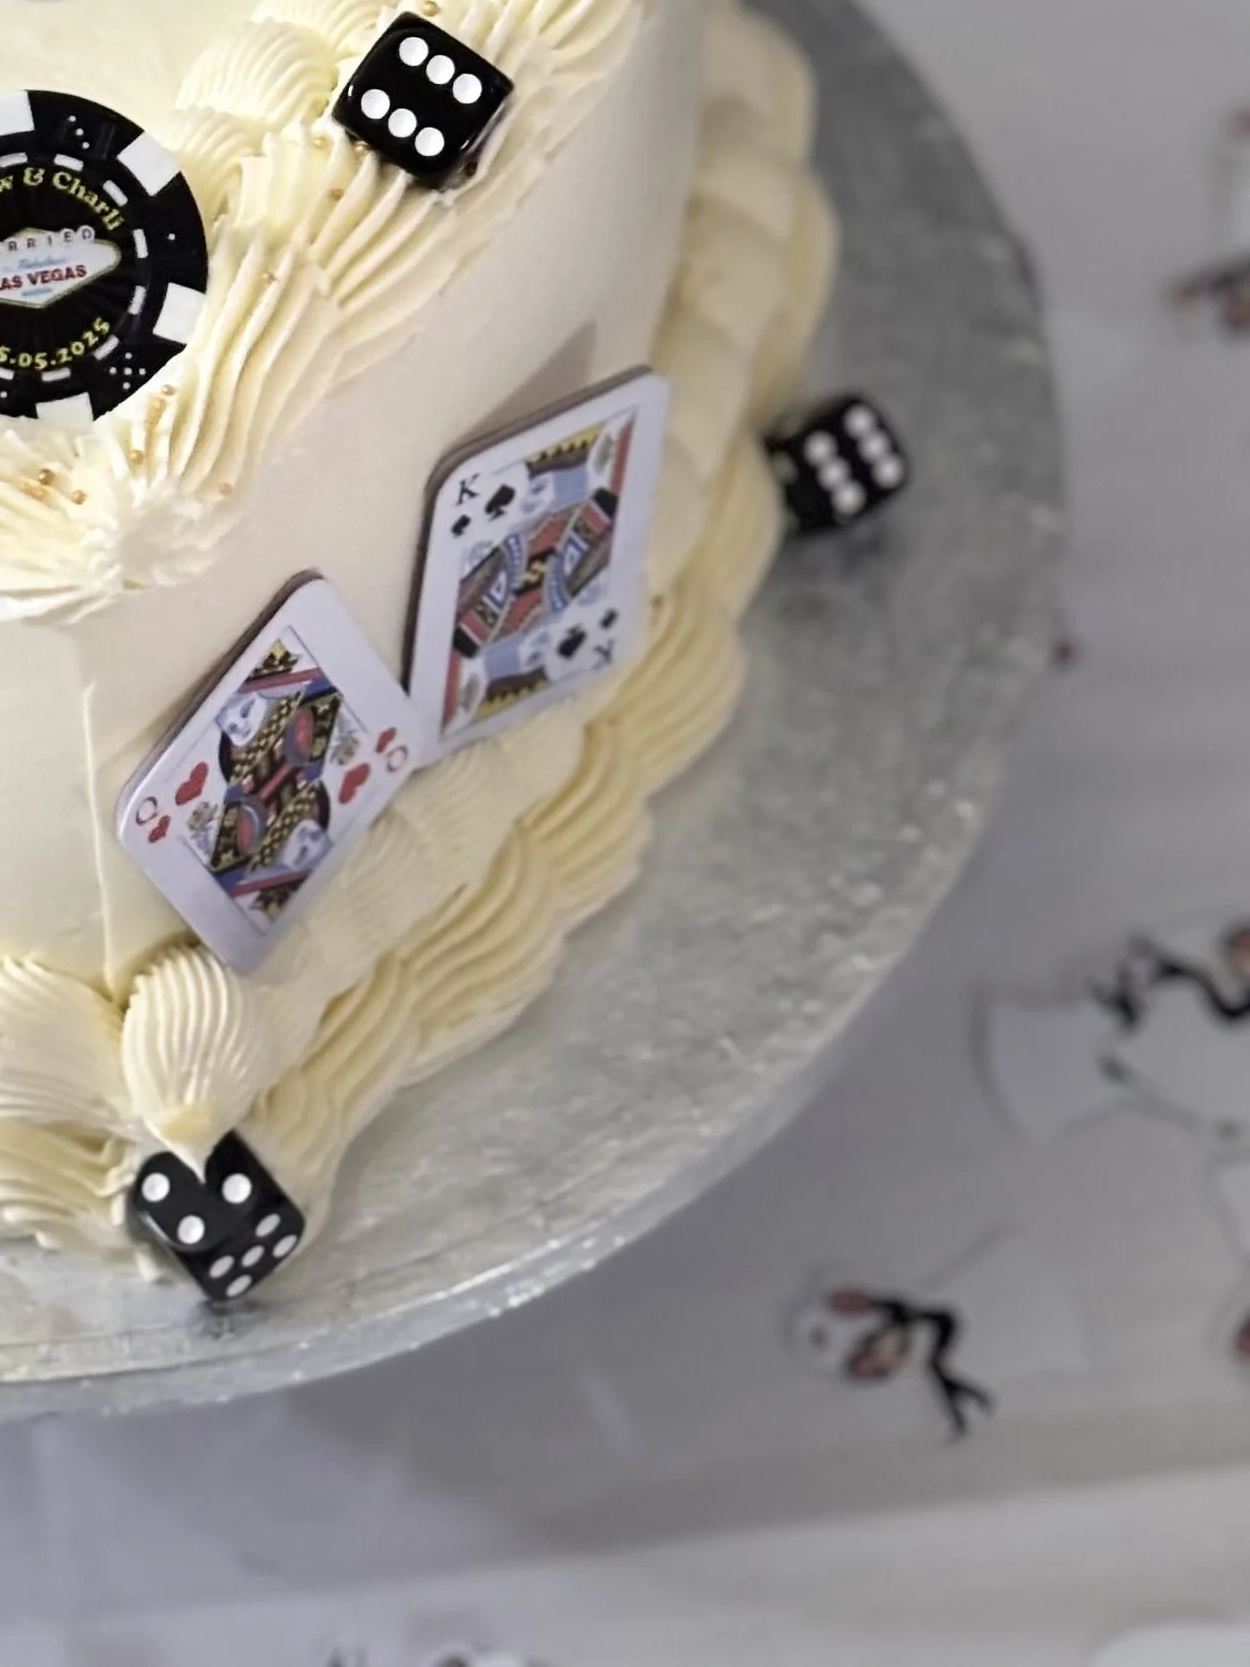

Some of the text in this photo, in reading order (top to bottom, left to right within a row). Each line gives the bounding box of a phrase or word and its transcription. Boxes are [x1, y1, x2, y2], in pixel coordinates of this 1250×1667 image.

[23, 167, 46, 186] &
[27, 264, 88, 285] VEGAS
[454, 473, 481, 506] K
